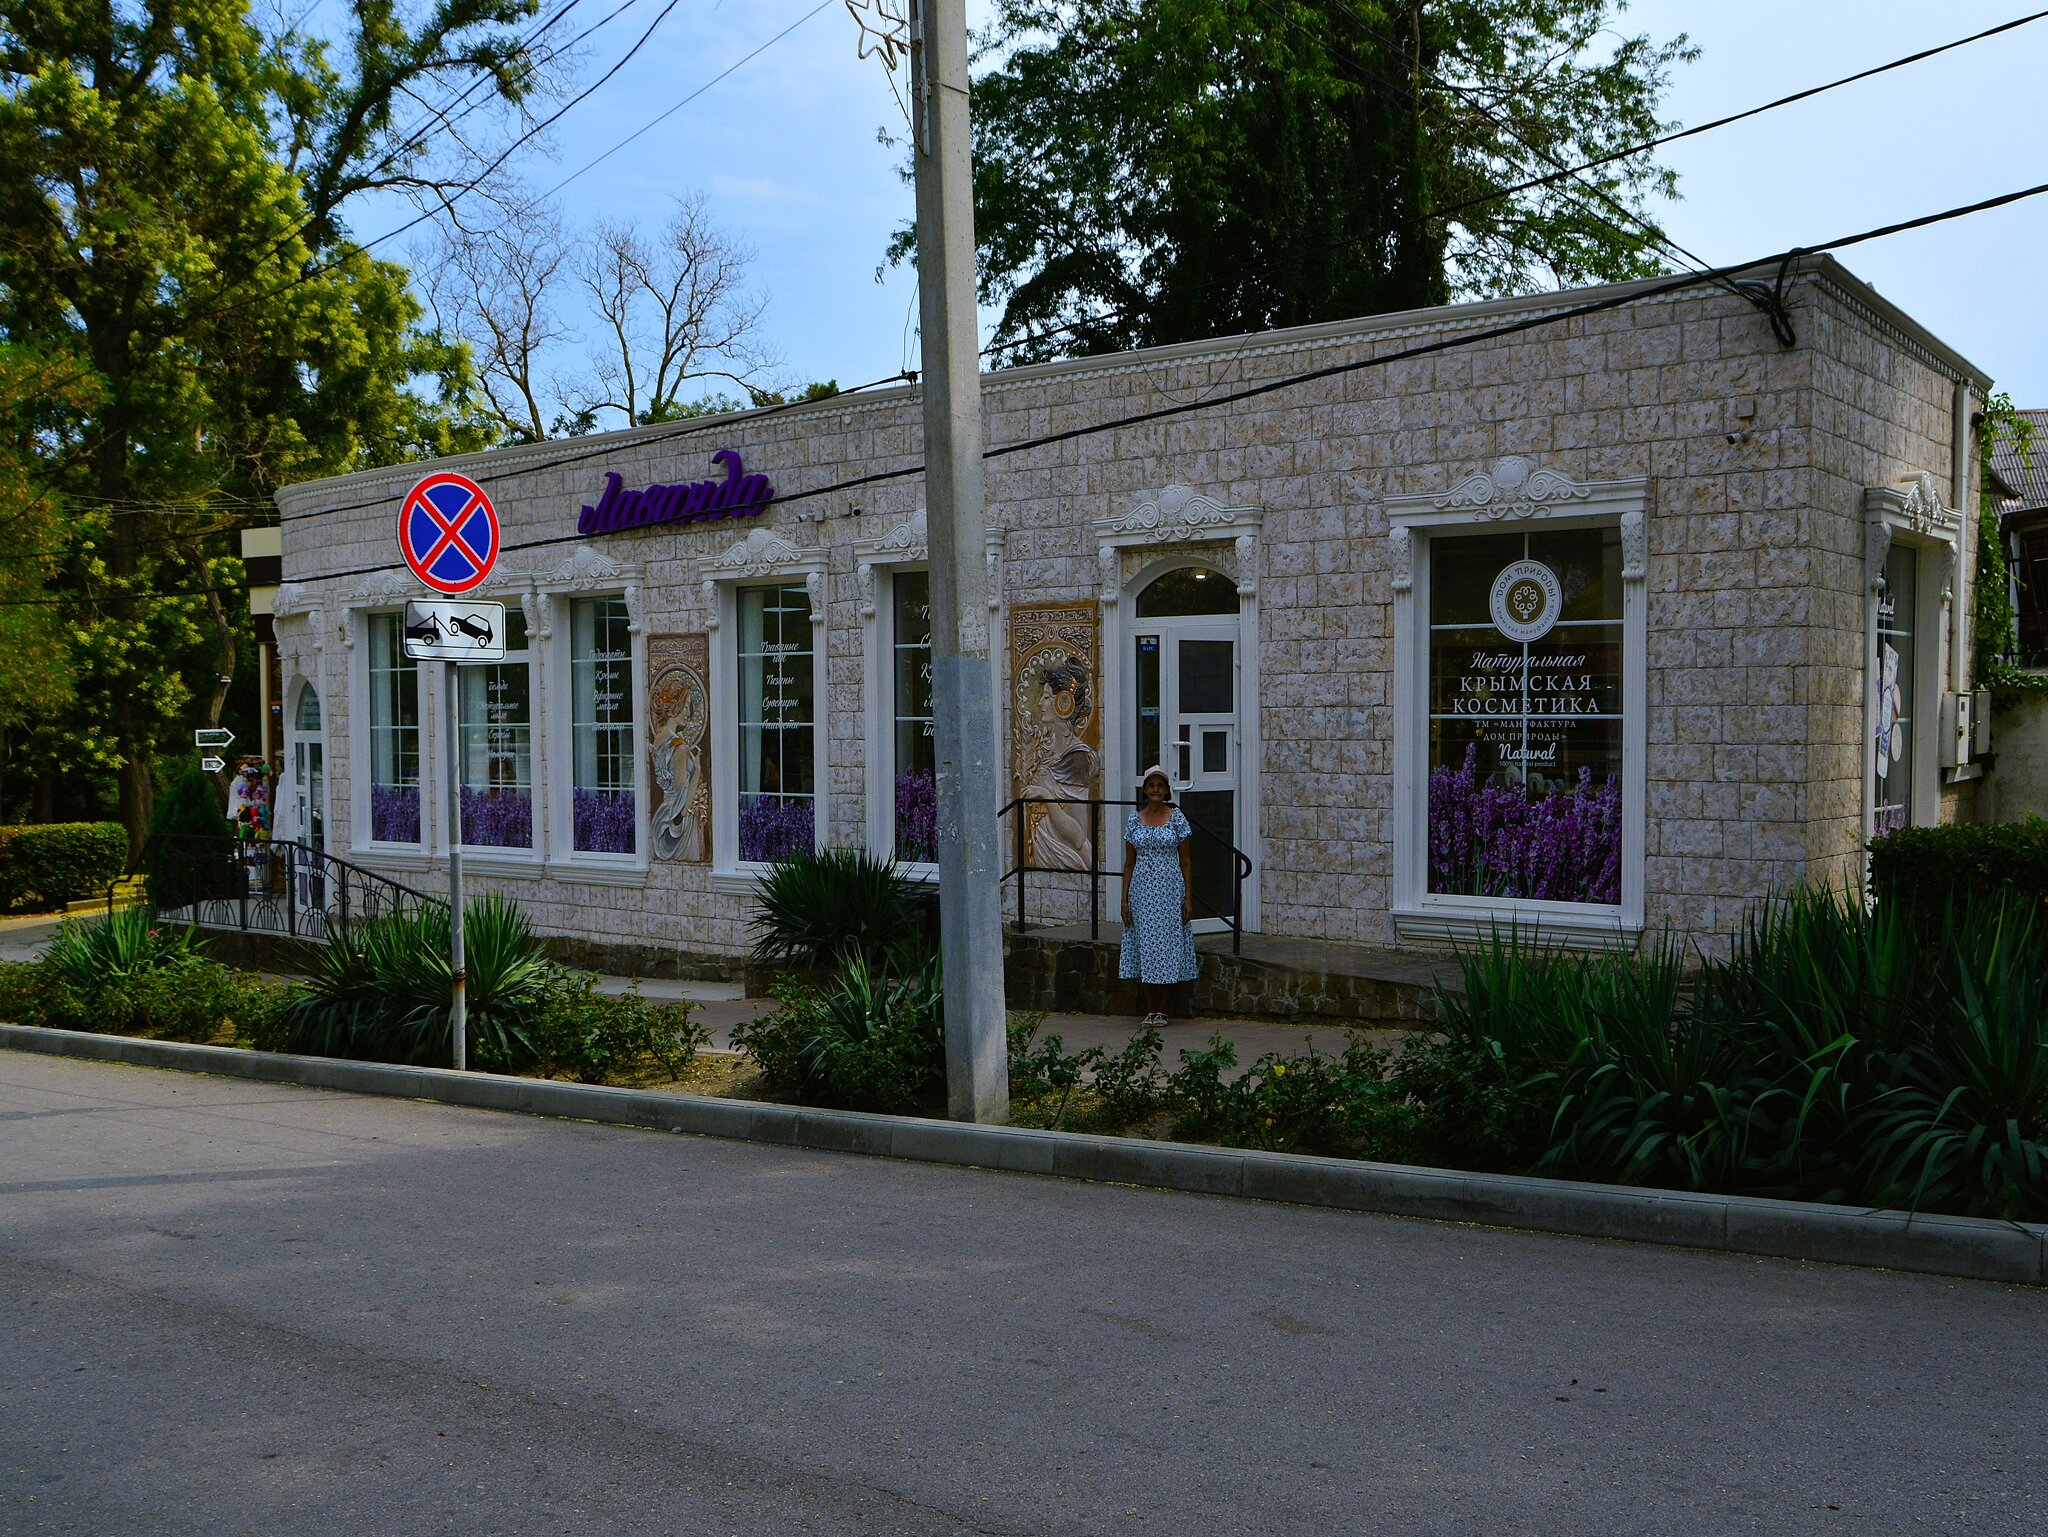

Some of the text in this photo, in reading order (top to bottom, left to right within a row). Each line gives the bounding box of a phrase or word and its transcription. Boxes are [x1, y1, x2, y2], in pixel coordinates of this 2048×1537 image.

[577, 450, 775, 534] Лаванда
[1470, 651, 1586, 674] Натуральная
[1460, 675, 1592, 692] КРЫМСКАЯ
[1453, 698, 1600, 714] КОСМЕТИКА
[1474, 720, 1490, 728] ТМ
[1483, 733, 1506, 741] ДОМ
[1498, 742, 1556, 760] Natural
